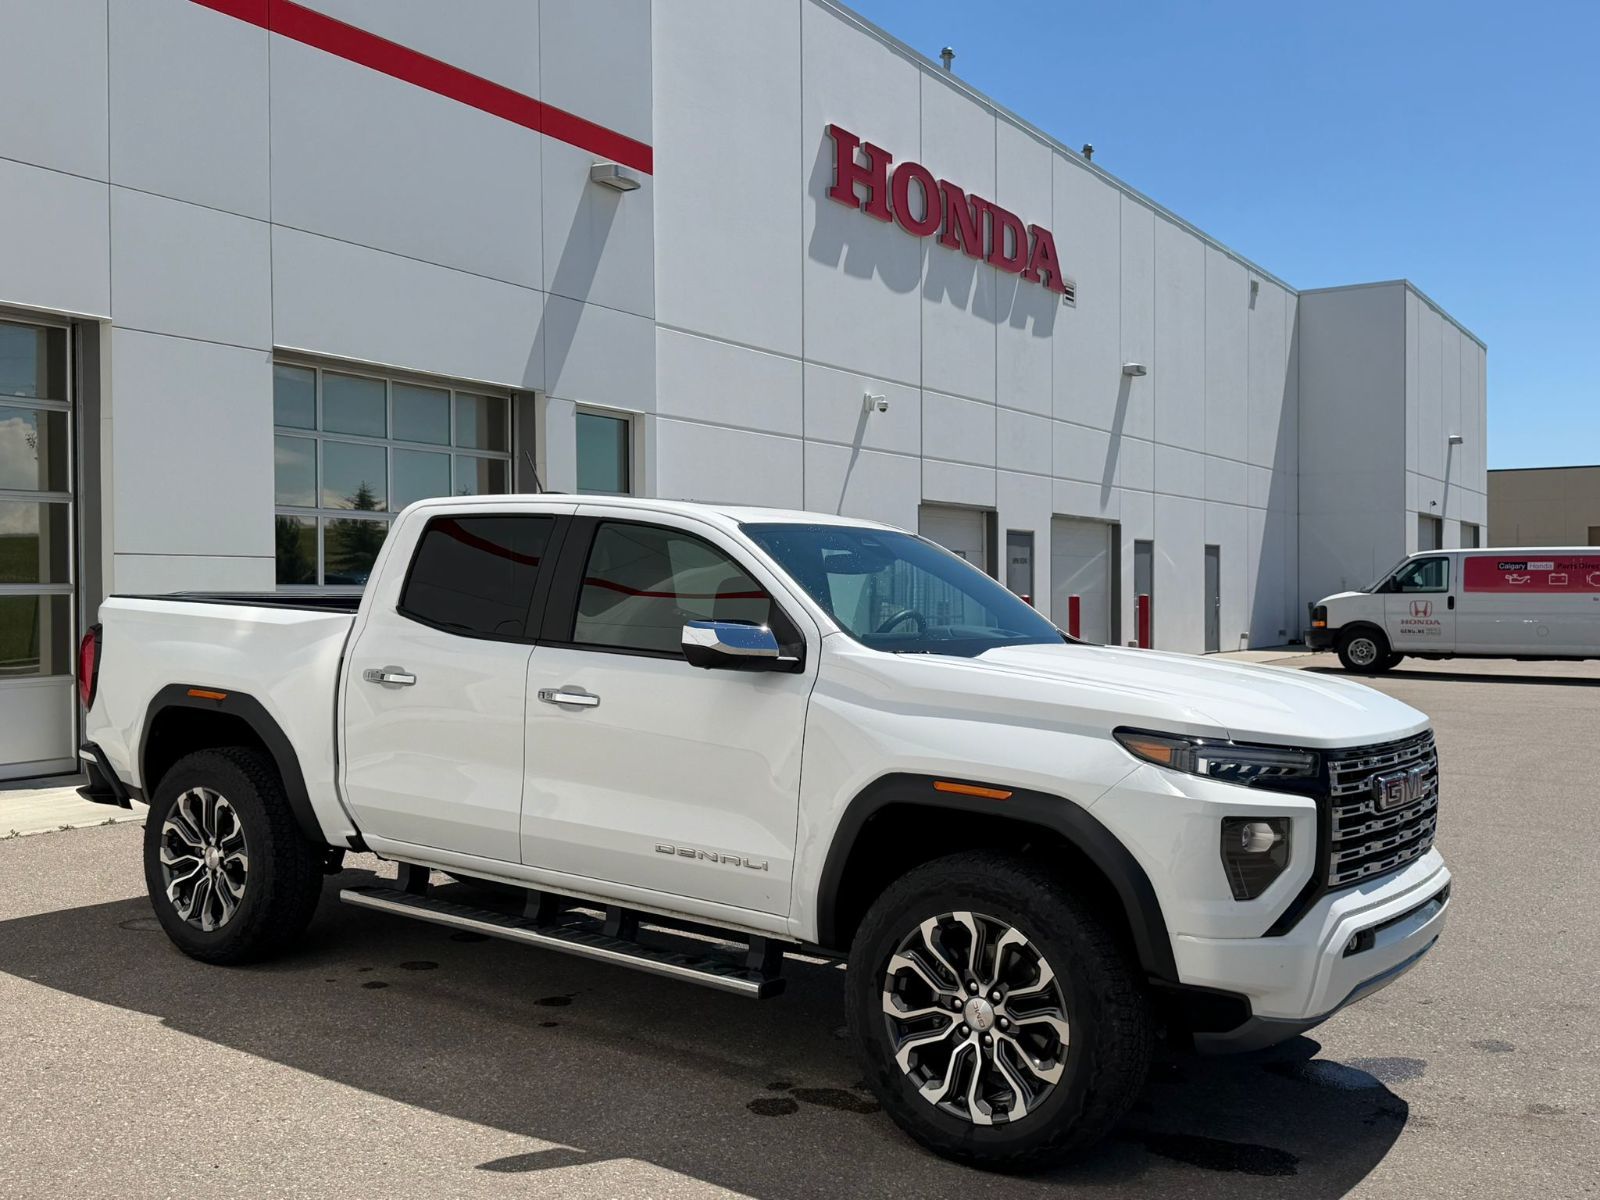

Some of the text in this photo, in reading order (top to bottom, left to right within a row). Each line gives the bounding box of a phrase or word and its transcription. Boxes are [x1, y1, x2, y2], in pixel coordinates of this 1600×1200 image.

[825, 123, 1067, 294] HONDA
[1499, 563, 1526, 571] Calgary
[1529, 562, 1553, 570] Honda
[1557, 562, 1577, 570] Parts
[1379, 763, 1430, 810] GMC
[655, 843, 768, 871] DENALI
[972, 1001, 985, 1028] GMC
